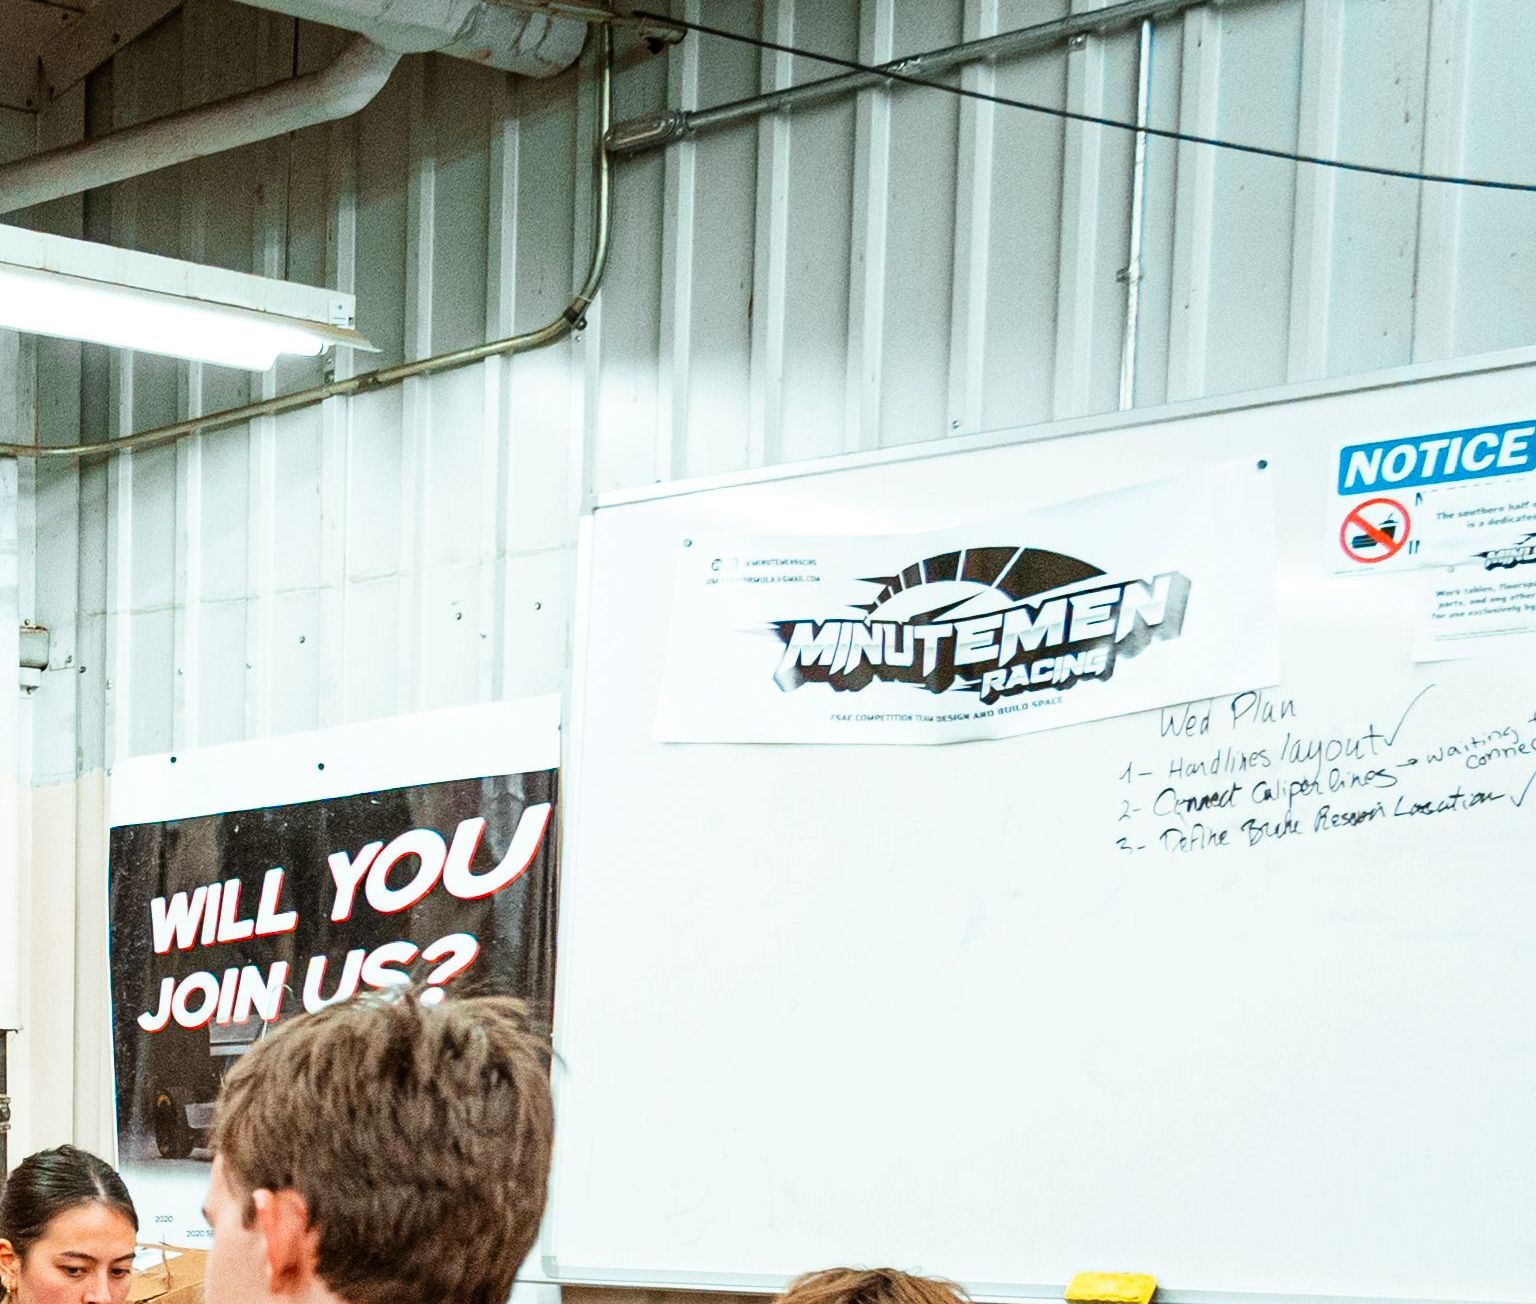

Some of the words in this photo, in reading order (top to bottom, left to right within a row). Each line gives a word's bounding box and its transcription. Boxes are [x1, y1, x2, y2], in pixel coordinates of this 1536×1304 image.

[1343, 426, 1536, 489] NOTICE
[776, 572, 1191, 692] MINUTEMEN
[980, 648, 1114, 704] RACING
[936, 713, 970, 722] DESIGN
[973, 709, 995, 720] AND
[997, 703, 1028, 716] BUILD
[1160, 698, 1212, 738] Wed
[1230, 690, 1297, 729] Plan
[151, 868, 299, 954] WILL
[328, 802, 552, 923] YOU
[137, 960, 289, 1033] JOIN
[303, 932, 480, 1016] US?
